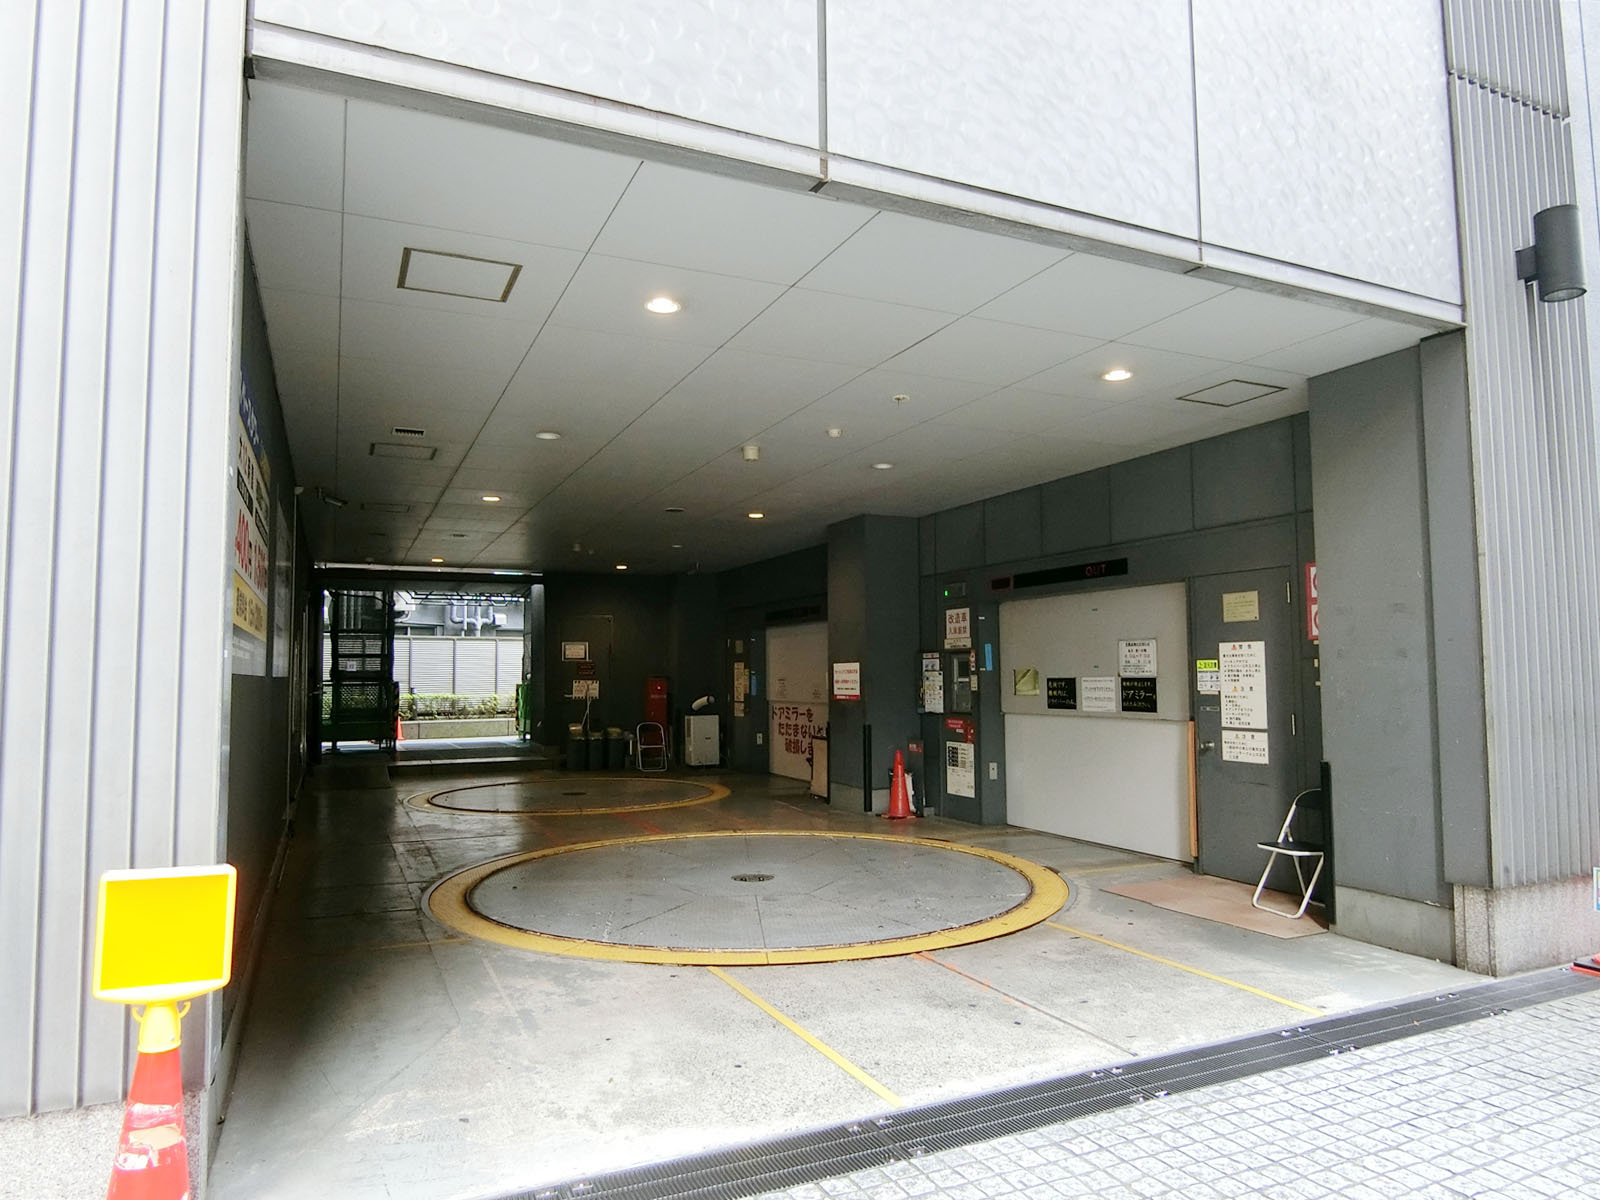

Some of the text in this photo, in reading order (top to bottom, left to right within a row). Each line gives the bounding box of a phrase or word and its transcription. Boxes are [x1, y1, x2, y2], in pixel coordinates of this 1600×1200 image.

[772, 705, 814, 723] ドアミラーを
[778, 722, 823, 739] たたまないと
